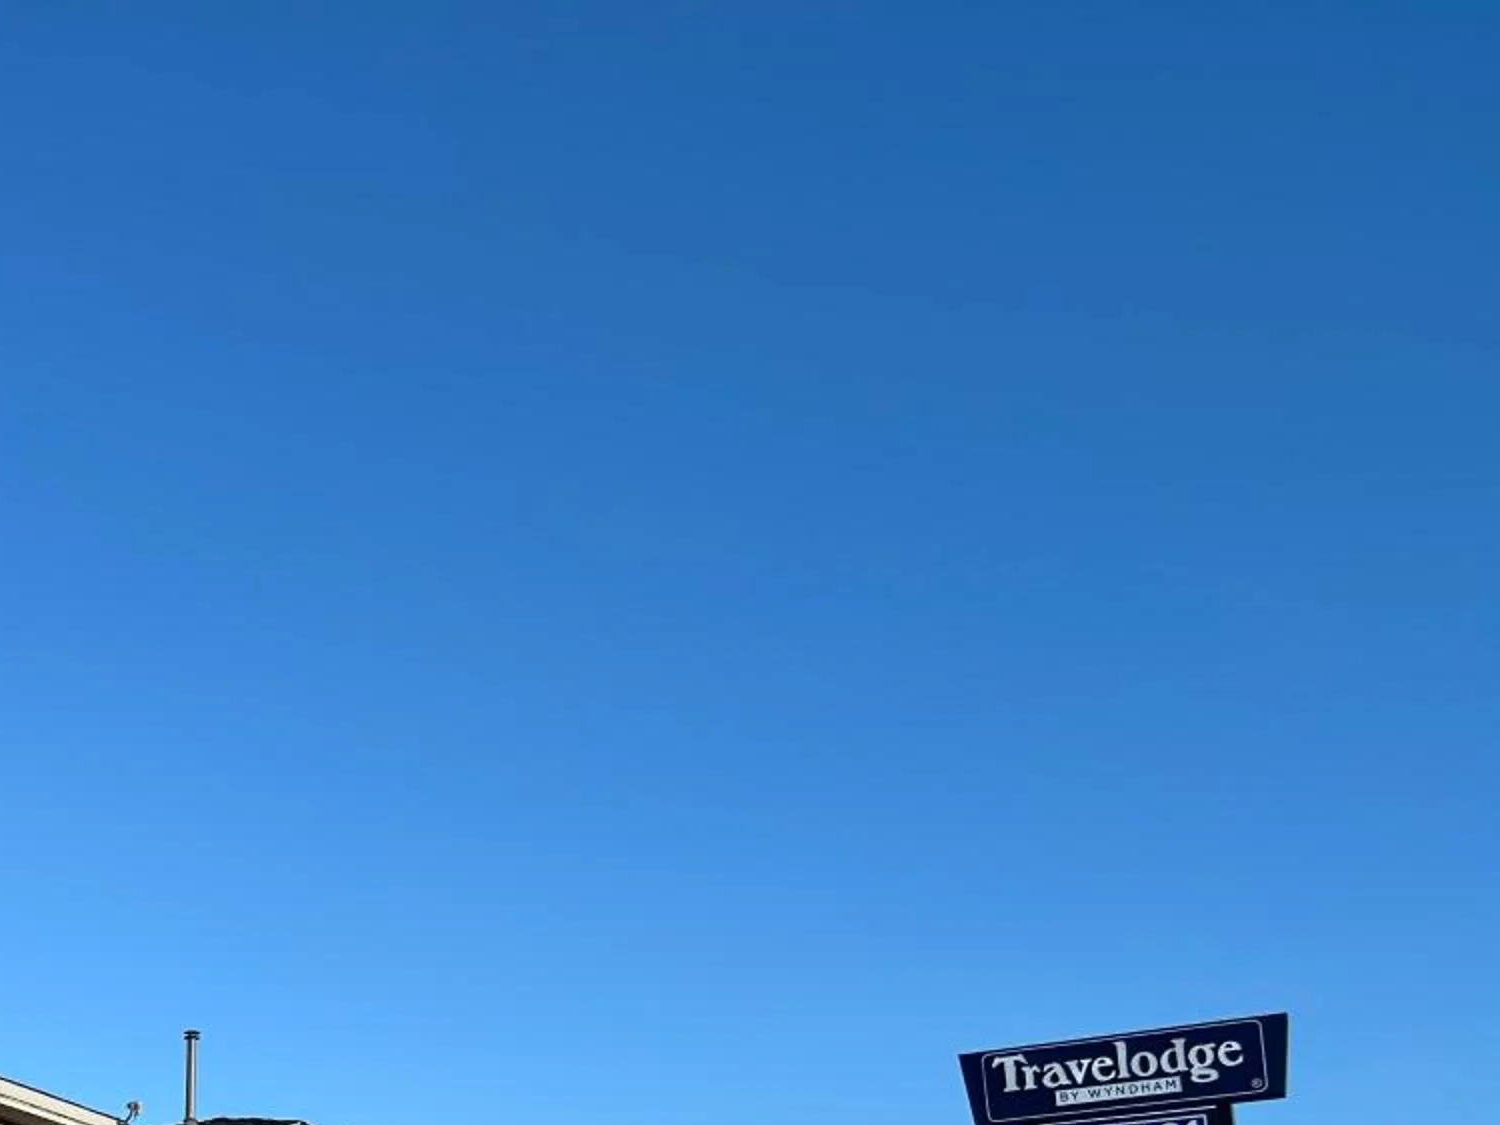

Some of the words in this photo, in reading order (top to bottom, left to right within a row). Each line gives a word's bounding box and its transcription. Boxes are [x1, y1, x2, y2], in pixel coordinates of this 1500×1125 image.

[992, 1038, 1245, 1093] Travelodge
[1058, 1090, 1080, 1103] BY
[1087, 1079, 1179, 1099] WYNDHAM
